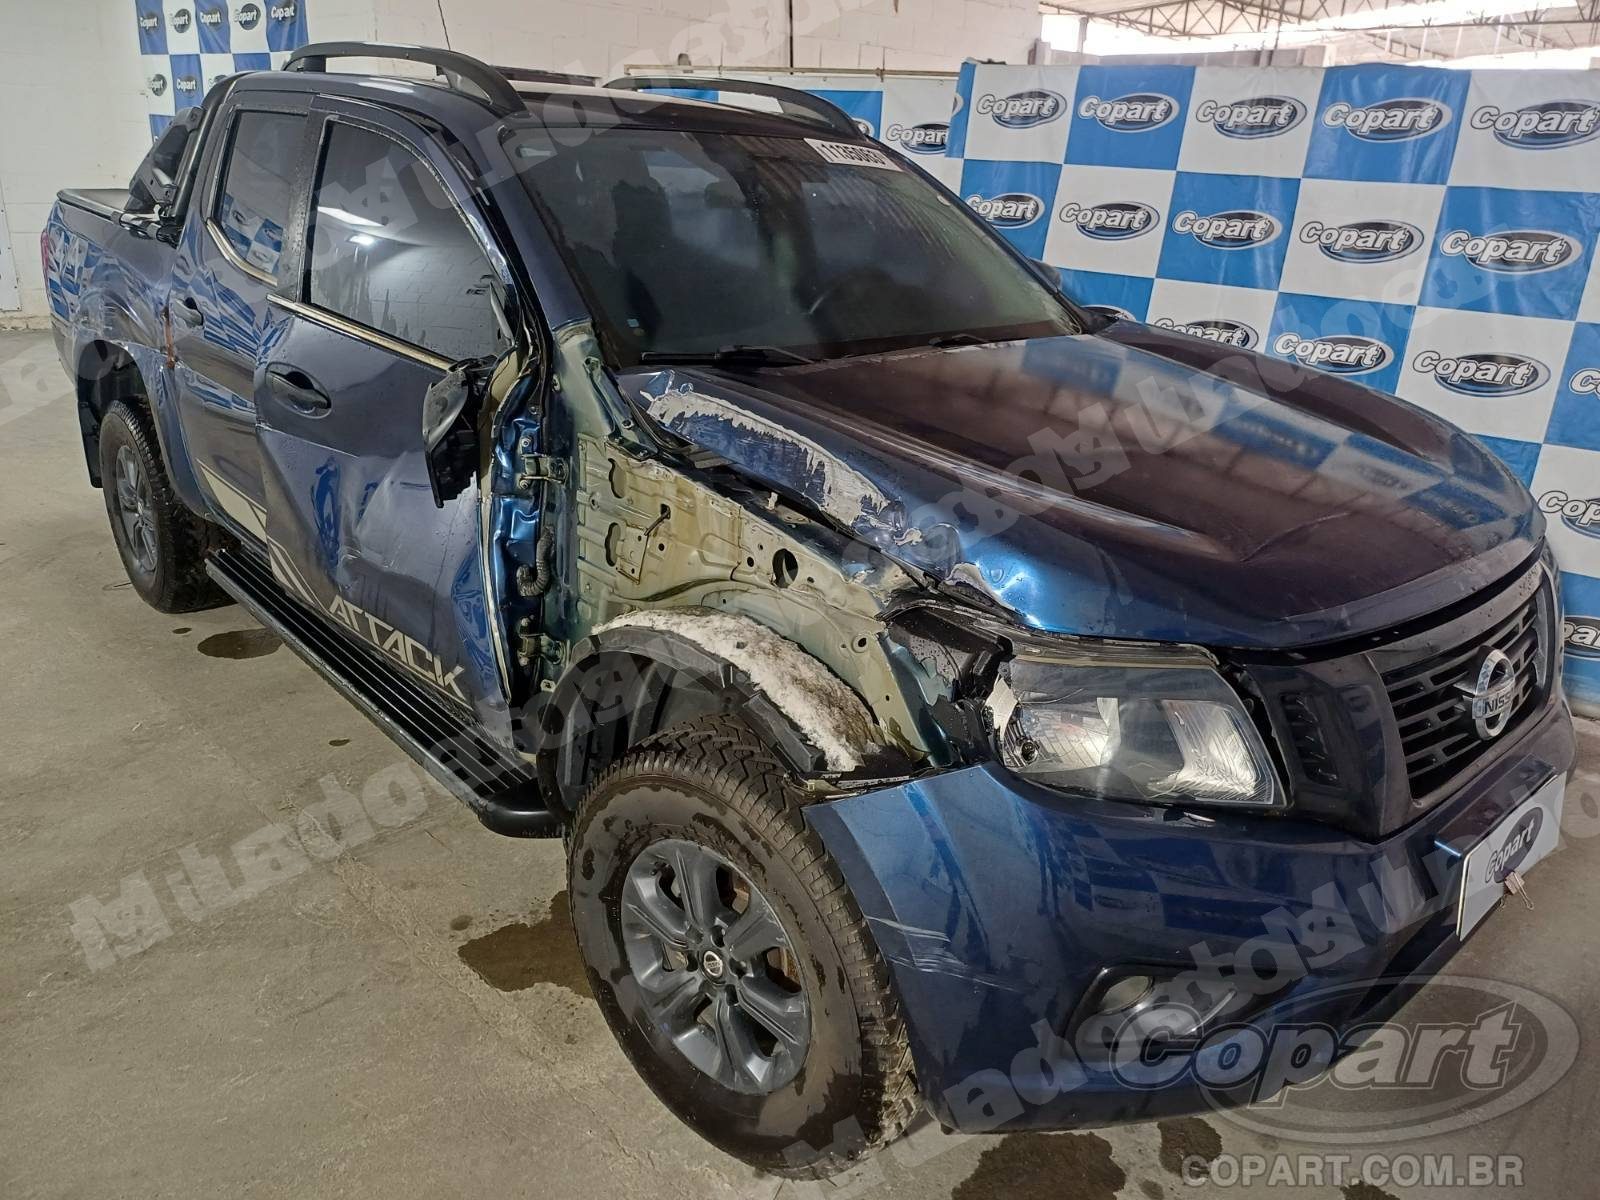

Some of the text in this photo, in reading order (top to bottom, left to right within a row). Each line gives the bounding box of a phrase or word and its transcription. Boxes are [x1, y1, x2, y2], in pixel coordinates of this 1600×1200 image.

[234, 9, 257, 22] Copart
[271, 5, 294, 21] Copart
[976, 93, 1060, 119] Copart
[1079, 96, 1174, 124] Copart
[1196, 100, 1293, 129] Copart
[1322, 102, 1441, 134] Copart
[886, 123, 950, 148] Copar
[1471, 105, 1600, 139] Copart
[966, 194, 1037, 222] Copart
[1059, 203, 1152, 231] Copart
[1172, 211, 1273, 242] Copart
[1299, 221, 1411, 253] Copart
[1440, 230, 1567, 263] Copart
[1274, 333, 1385, 367] Copart
[1412, 350, 1533, 387] Copart
[329, 594, 466, 701] ATTACK
[1485, 817, 1536, 884] Copart
